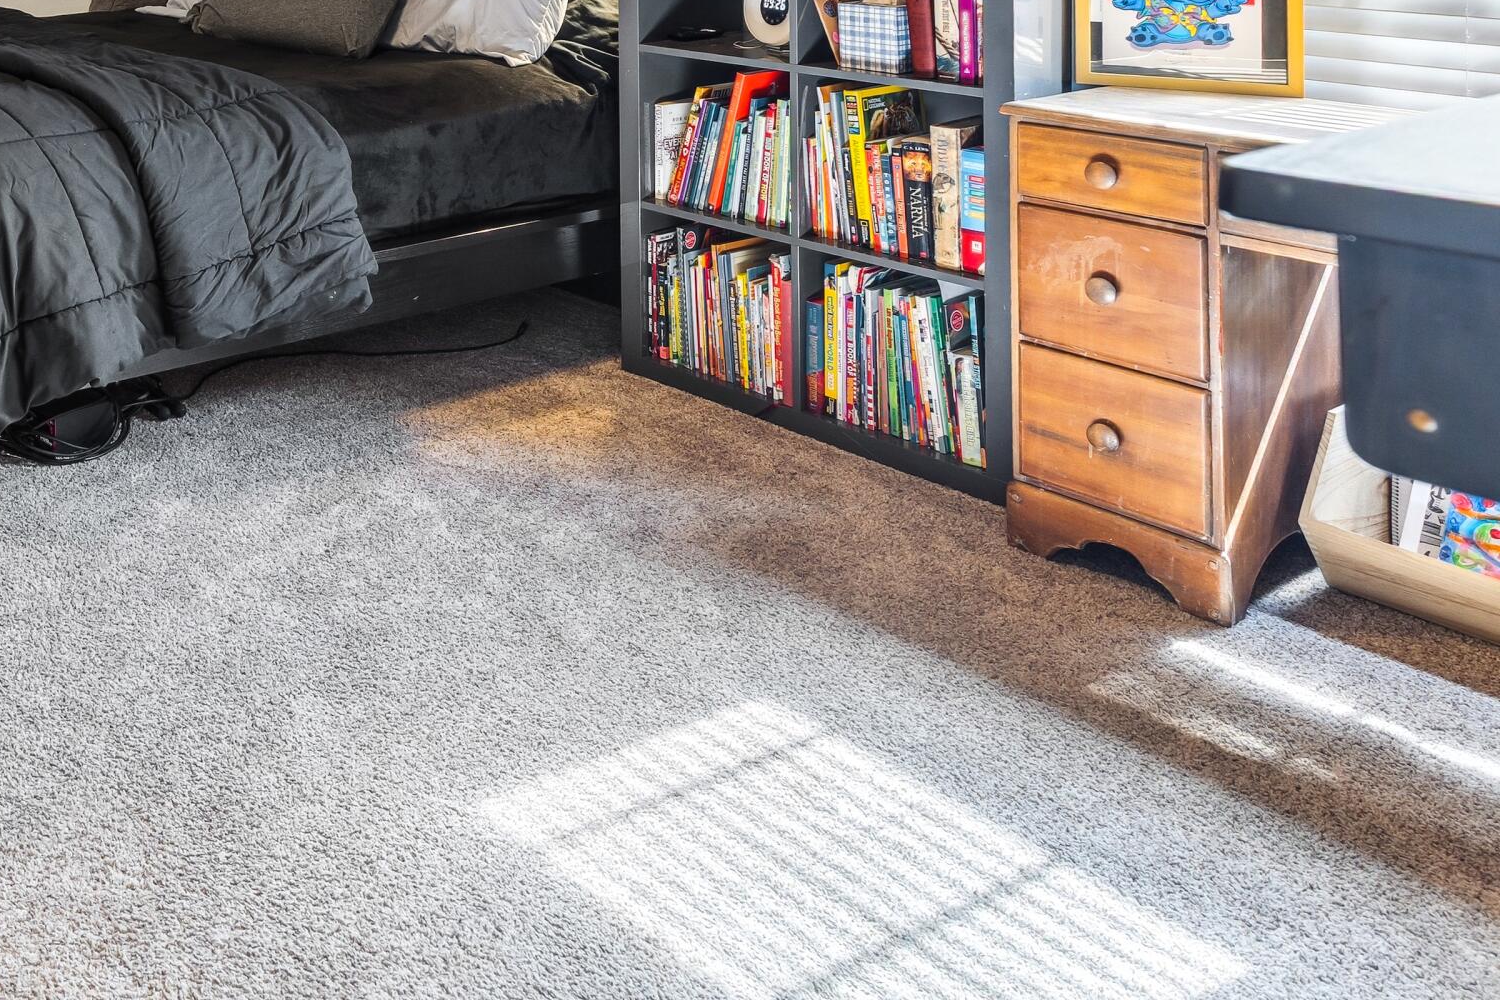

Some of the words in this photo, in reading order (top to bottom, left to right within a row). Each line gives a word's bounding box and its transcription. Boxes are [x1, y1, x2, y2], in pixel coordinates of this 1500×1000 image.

[762, 173, 768, 182] OF
[909, 186, 924, 238] NARNIA
[773, 286, 781, 296] Big
[773, 297, 781, 314] Book
[847, 343, 855, 364] BOOK
[847, 366, 854, 377] OF
